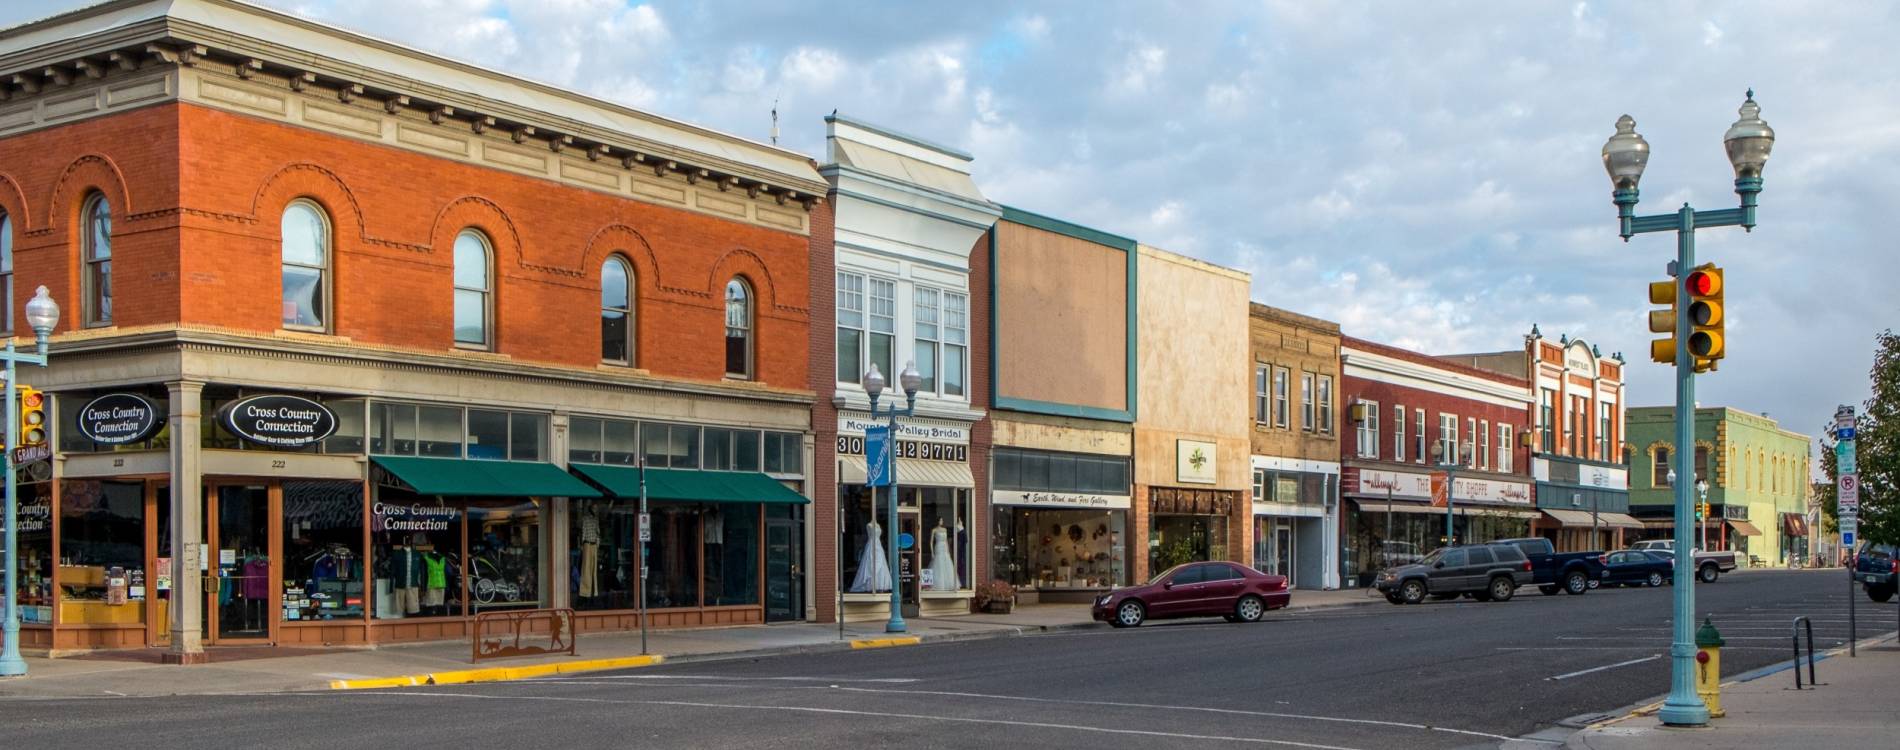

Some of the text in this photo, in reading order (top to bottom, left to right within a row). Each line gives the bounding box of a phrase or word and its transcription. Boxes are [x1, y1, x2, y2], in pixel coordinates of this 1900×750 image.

[88, 406, 145, 420] Cross Country
[247, 405, 321, 424] Cross Country
[94, 420, 139, 433] Connection
[255, 419, 314, 433] Connection
[897, 424, 929, 437] Valley
[931, 428, 961, 438] Bridal
[272, 460, 286, 468] 222
[373, 502, 456, 519] Cross Country
[384, 517, 448, 530] Connection
